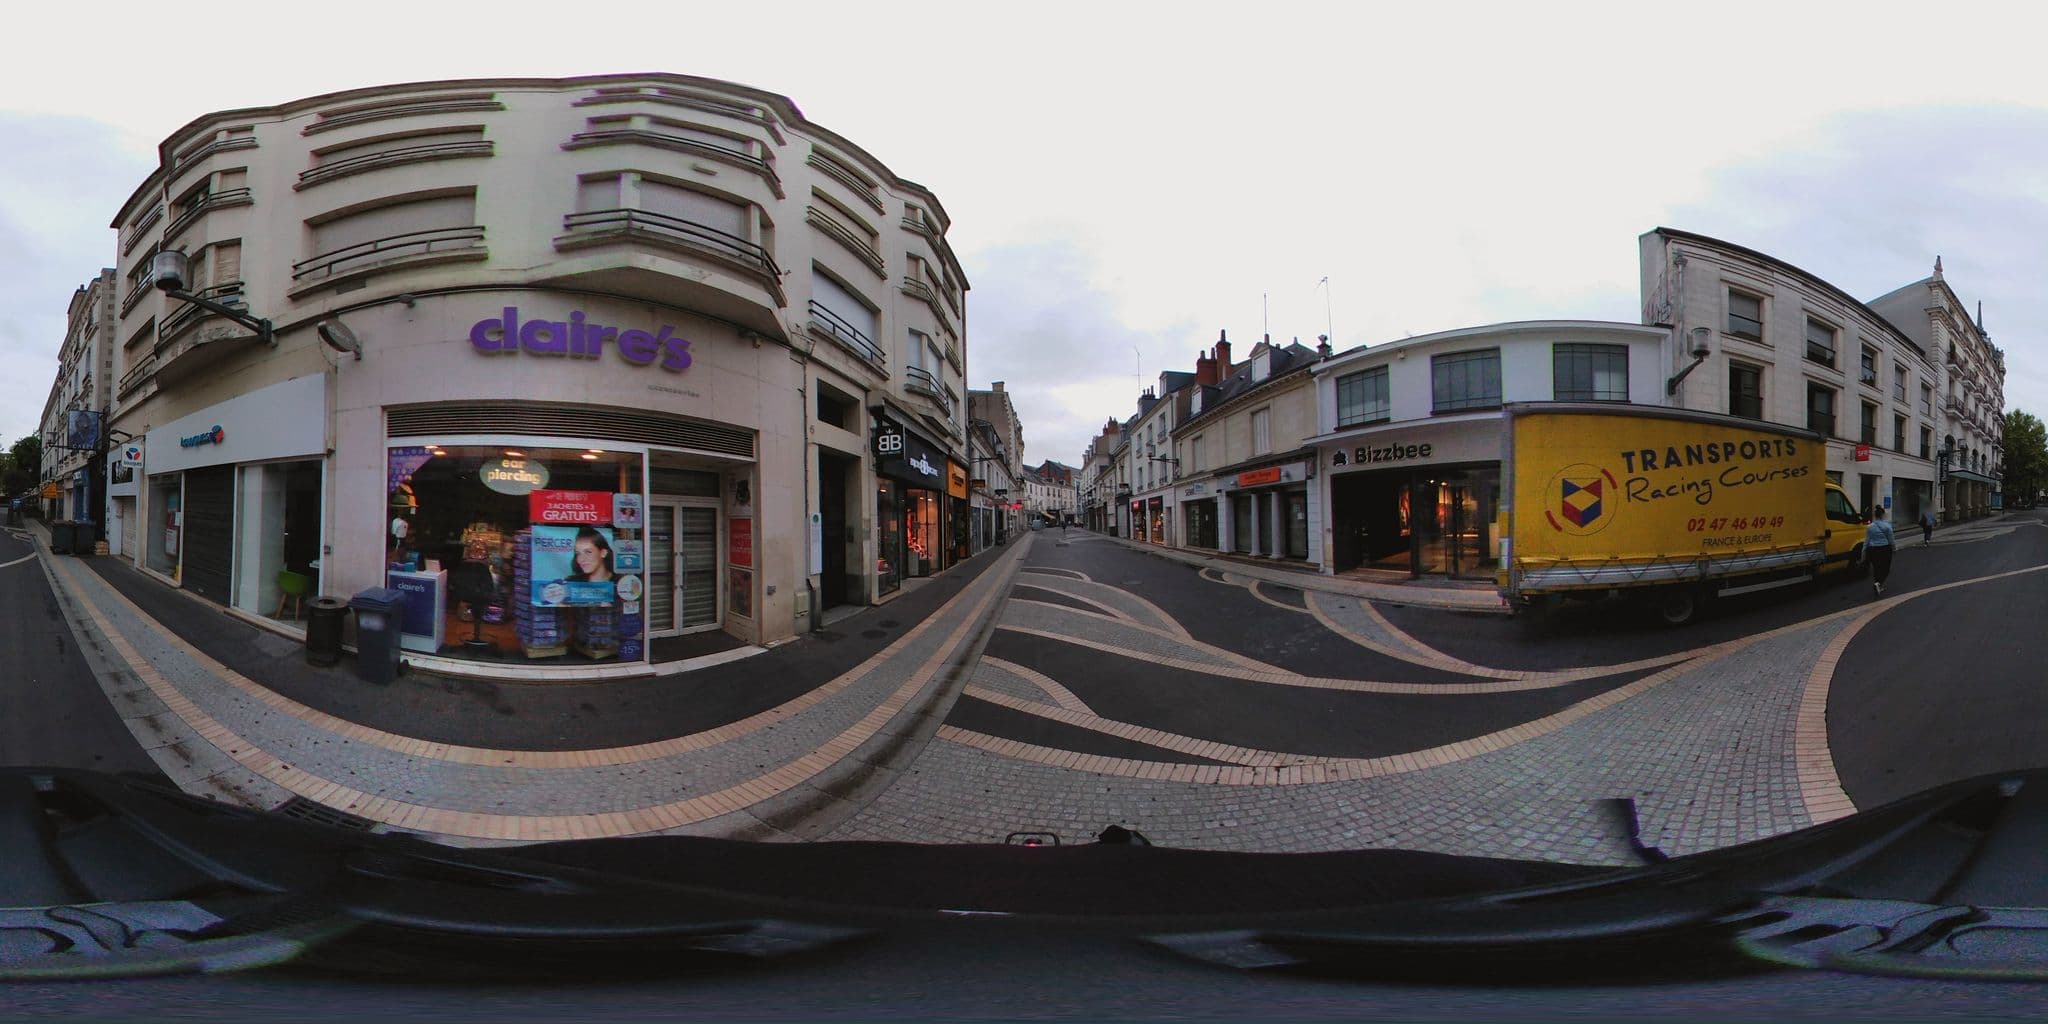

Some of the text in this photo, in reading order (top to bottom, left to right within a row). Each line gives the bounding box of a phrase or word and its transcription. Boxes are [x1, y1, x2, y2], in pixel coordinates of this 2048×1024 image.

[470, 307, 692, 371] claire's
[1355, 443, 1432, 464] Bizzbee
[1622, 438, 1797, 474] TRANSPORTS
[502, 459, 524, 468] ear
[488, 469, 540, 484] piercing
[1625, 464, 1808, 505] Racing Courses
[543, 510, 598, 521] GRATUITS
[1687, 516, 1784, 532] 02 47 46 49 49
[1703, 535, 1735, 547] FRANCE
[1744, 533, 1773, 545] EUROPE
[398, 582, 424, 592] claire's
